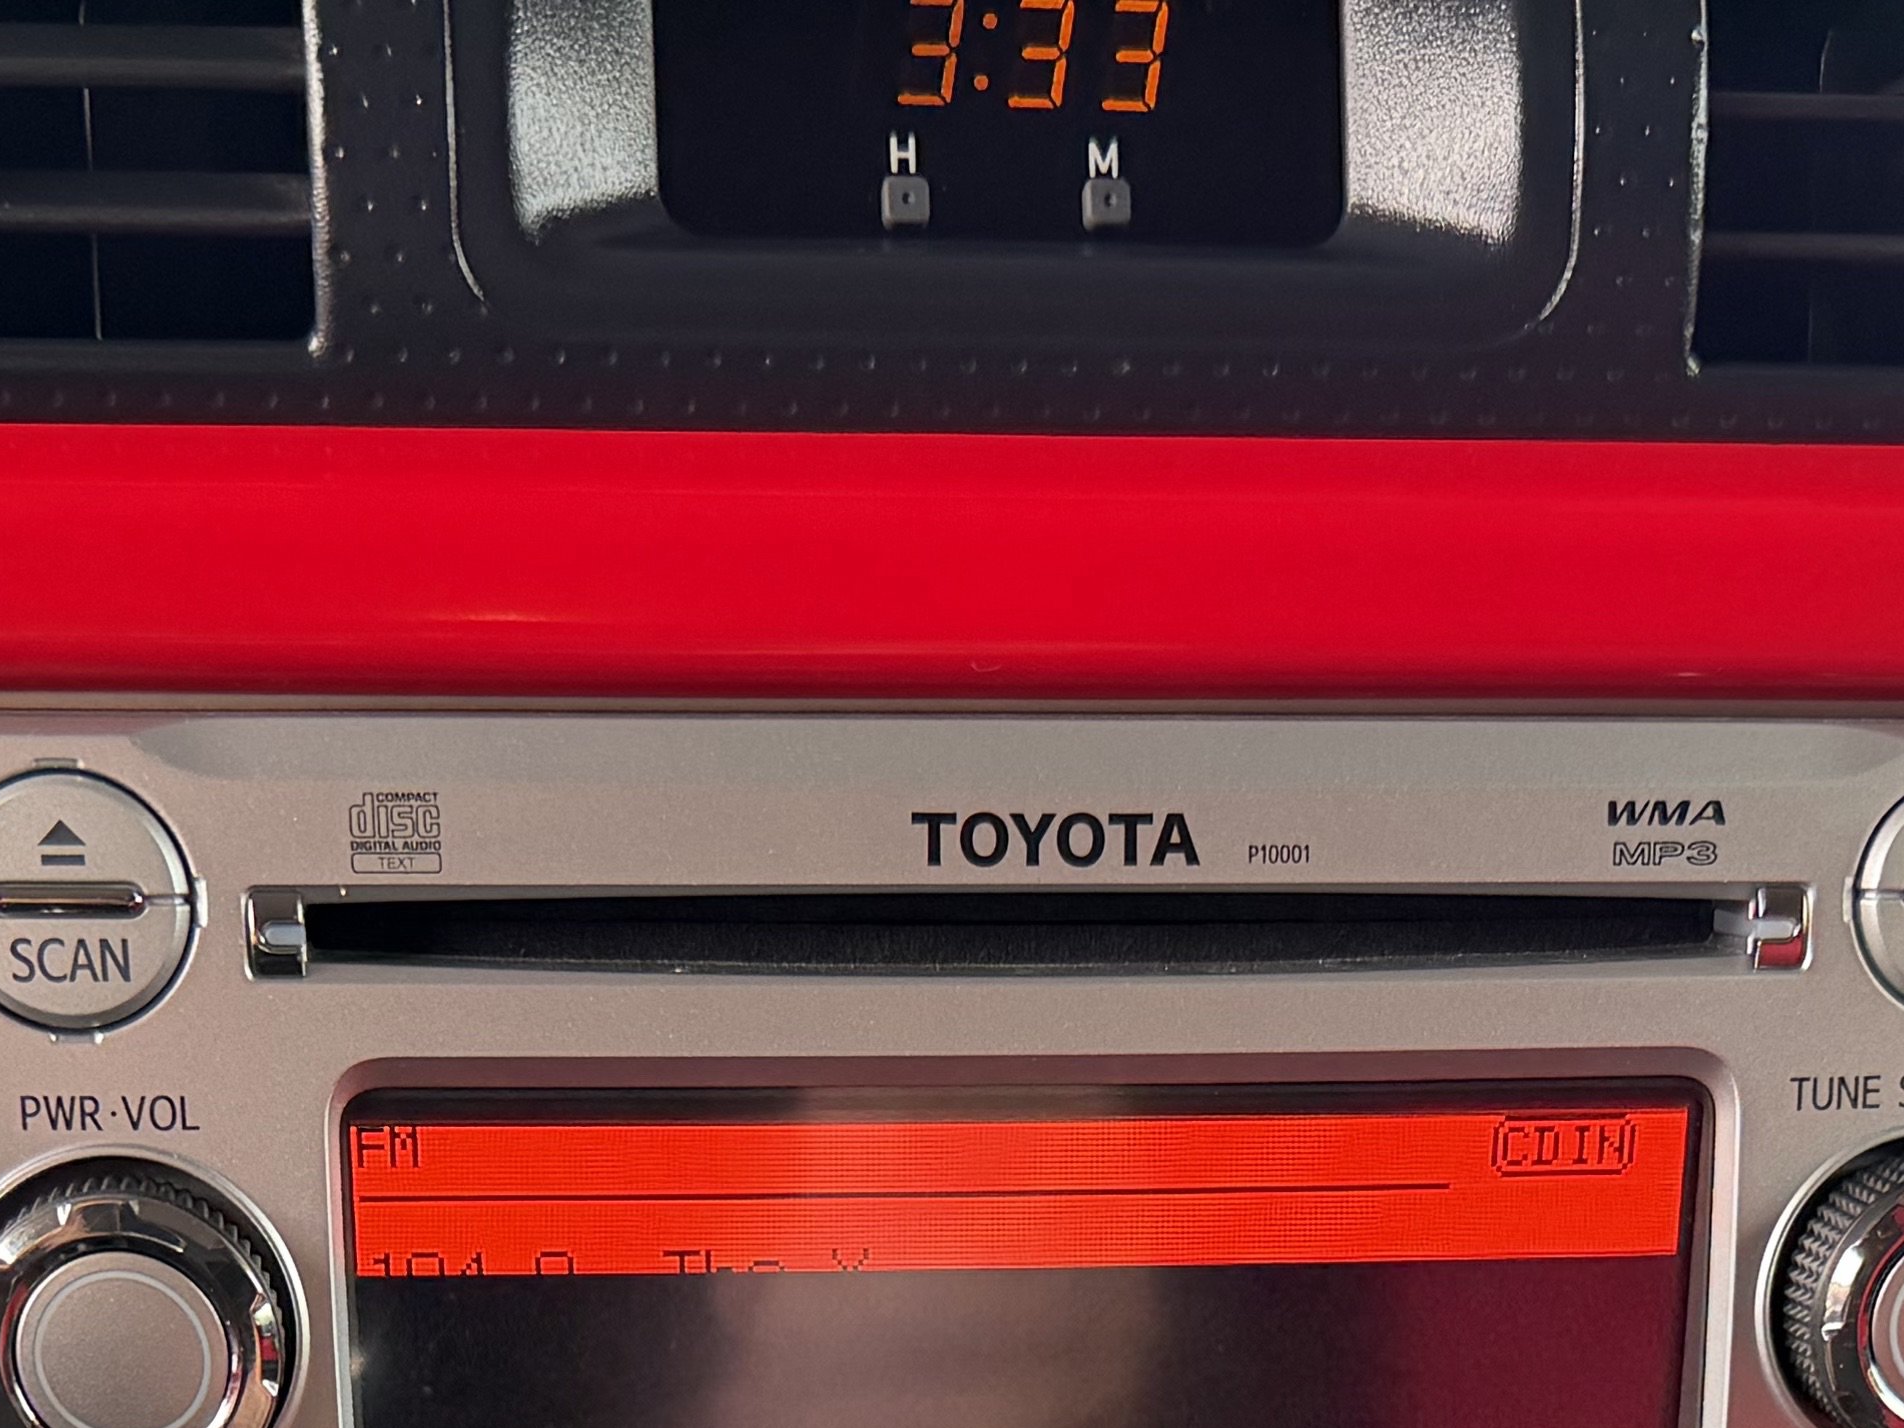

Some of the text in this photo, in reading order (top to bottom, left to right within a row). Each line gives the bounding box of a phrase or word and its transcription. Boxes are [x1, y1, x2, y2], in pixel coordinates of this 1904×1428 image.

[897, 0, 1168, 112] 3:33
[889, 131, 917, 174] H
[1088, 136, 1120, 179] M
[349, 792, 441, 839] disc
[376, 791, 439, 803] COMPACT
[1607, 799, 1726, 826] WMA
[350, 839, 442, 852] DIGITAL AUDIO
[911, 811, 1201, 868] TOYOTA
[1248, 844, 1310, 865] P10001
[1612, 840, 1718, 867] MP3
[377, 856, 416, 870] TEXT
[10, 937, 132, 983] SCAN
[1789, 1074, 1882, 1112] TUNE
[357, 1127, 419, 1168] FM
